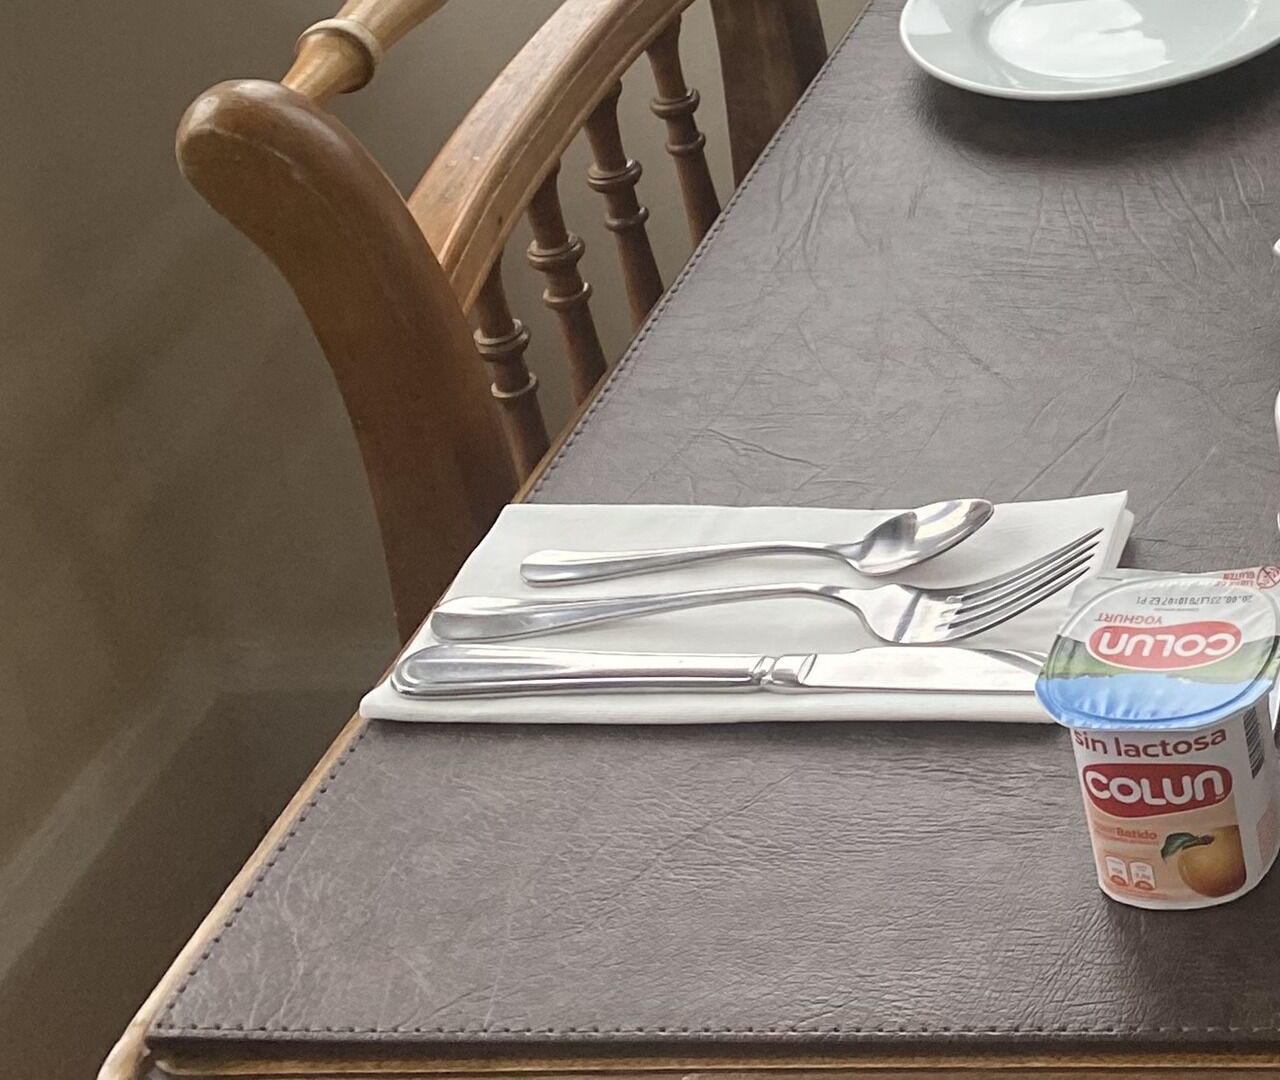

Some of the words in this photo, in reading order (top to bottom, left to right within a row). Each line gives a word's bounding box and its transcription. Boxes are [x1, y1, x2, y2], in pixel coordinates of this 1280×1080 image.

[1094, 613, 1163, 625] YOGHURT
[1097, 631, 1236, 657] COLUN
[1073, 729, 1108, 755] sin
[1114, 728, 1227, 758] lactosa
[1085, 770, 1224, 806] COLUN
[1116, 826, 1158, 840] Batido
